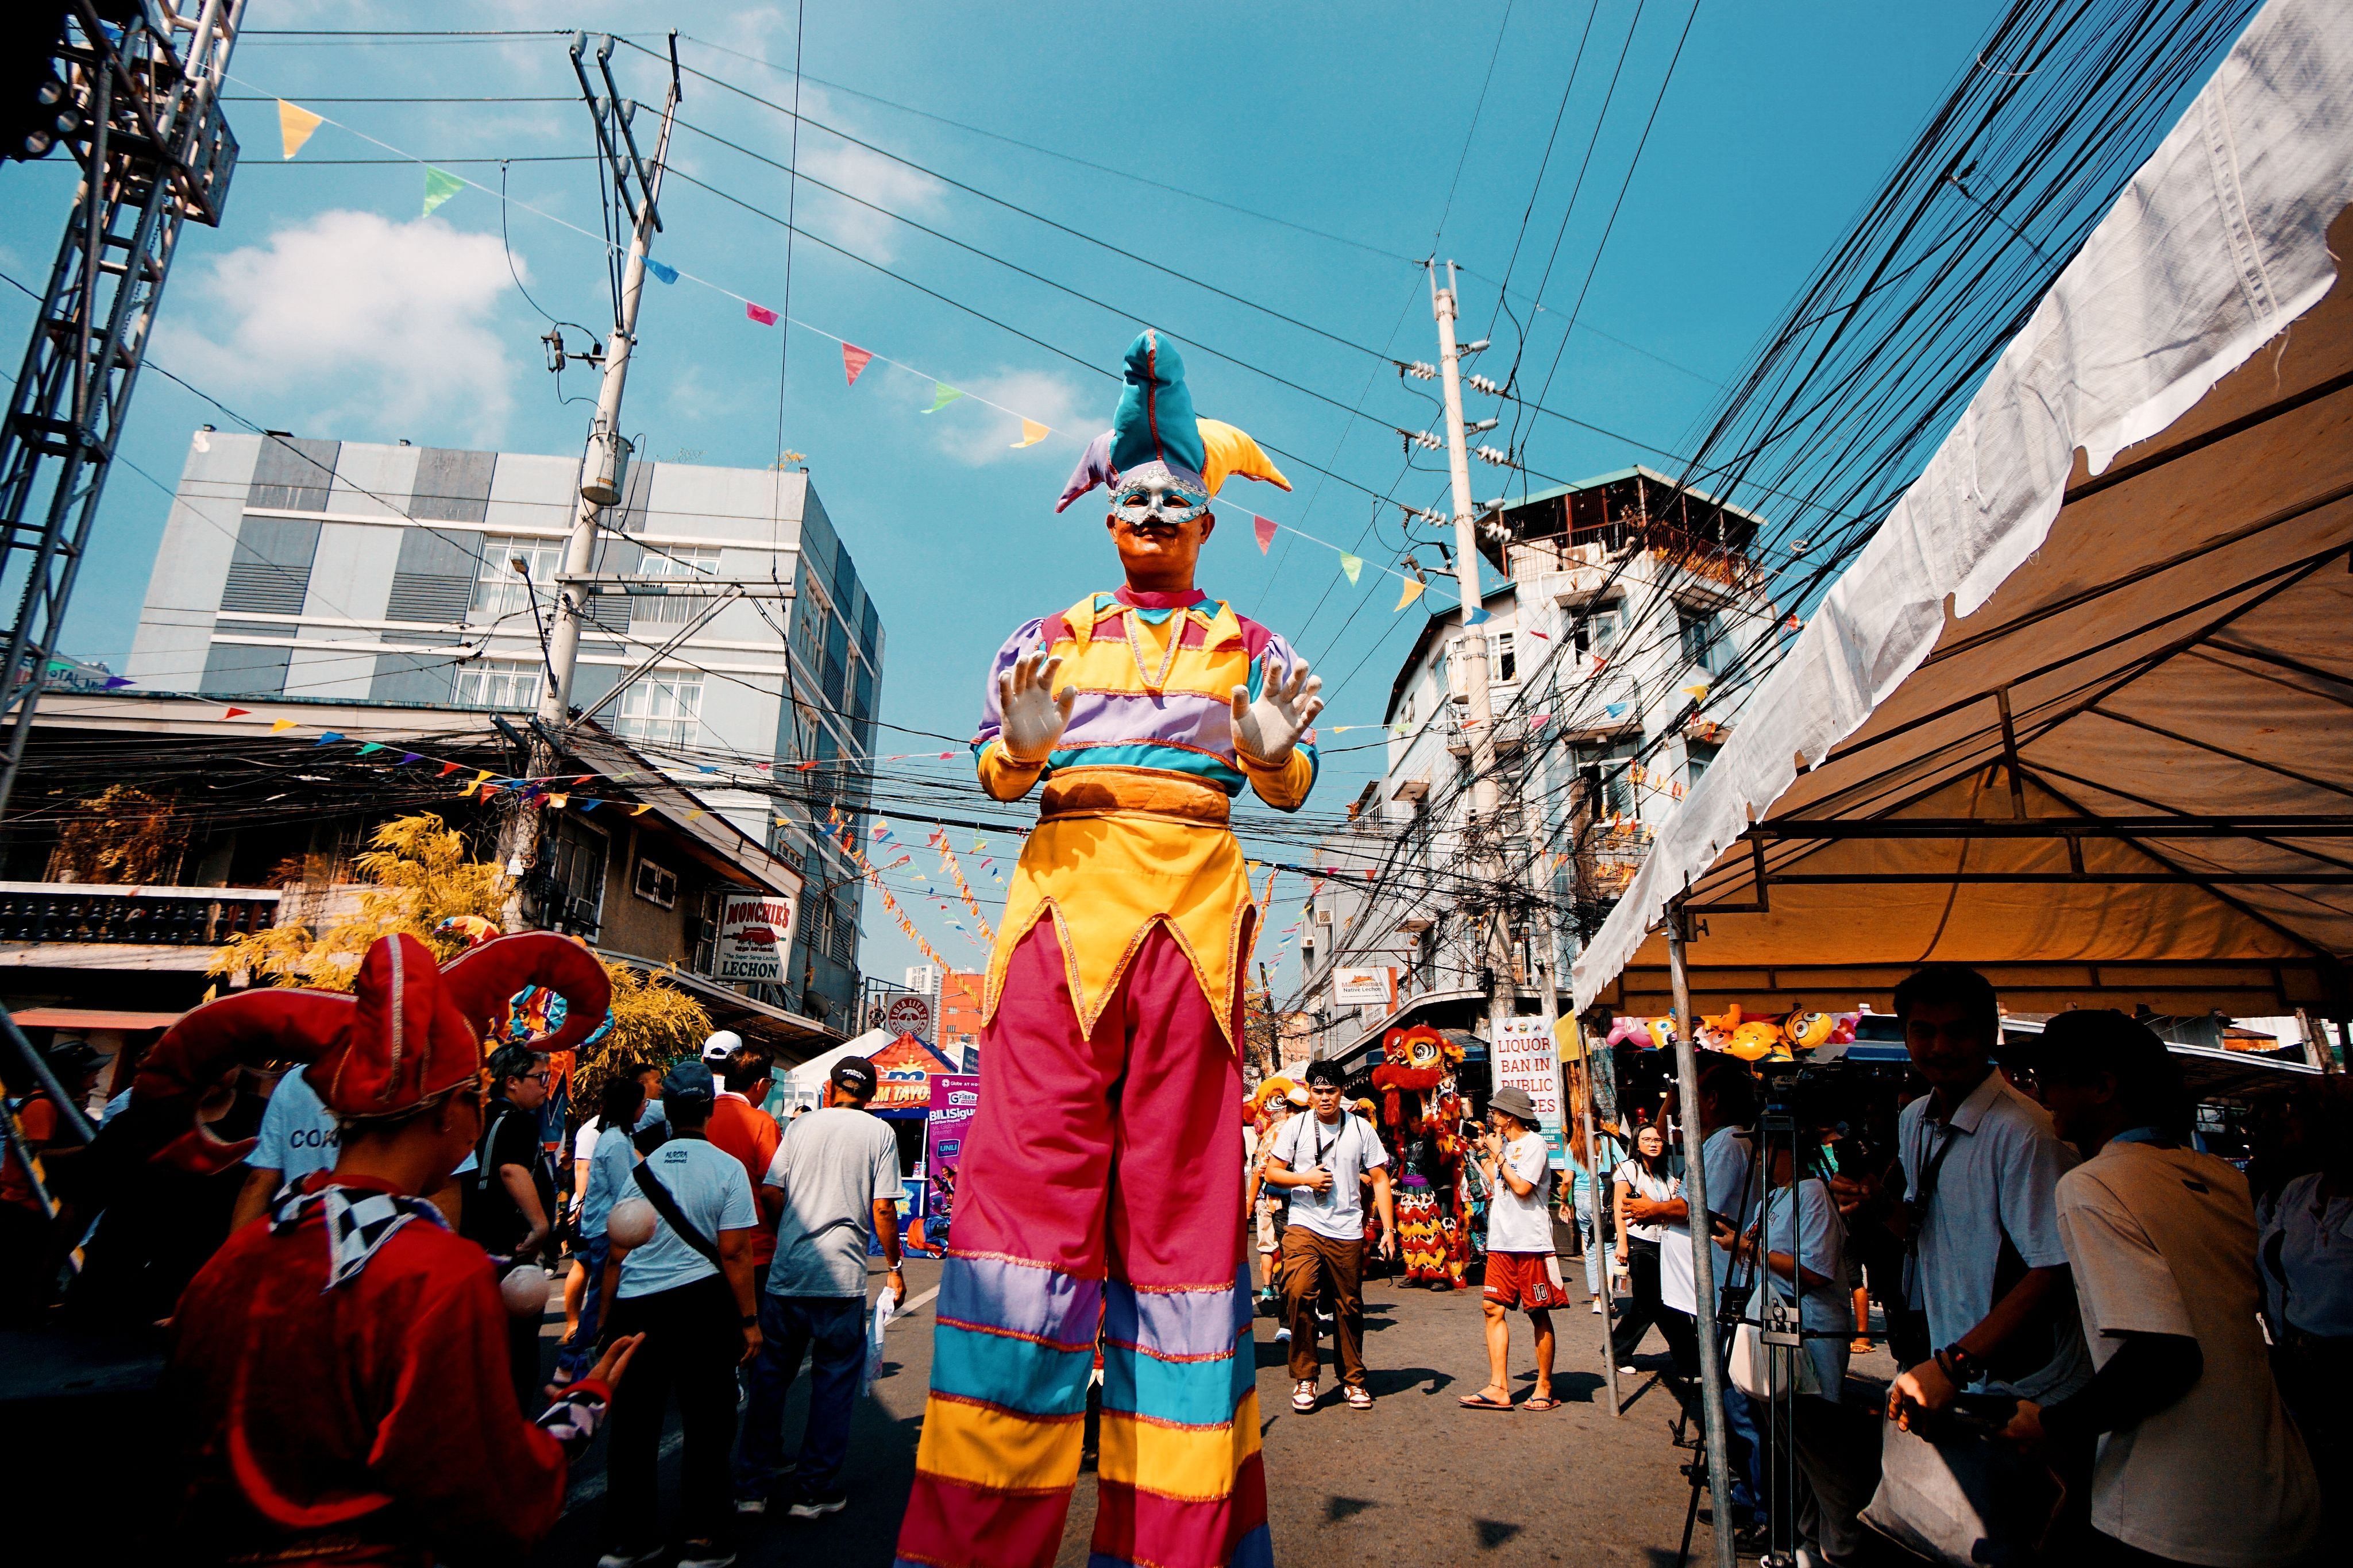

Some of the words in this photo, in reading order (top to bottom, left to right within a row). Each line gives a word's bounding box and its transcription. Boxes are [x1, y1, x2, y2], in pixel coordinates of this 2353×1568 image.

[726, 902, 790, 928] MONCHIE'S
[722, 961, 778, 978] LECHON
[892, 1001, 907, 1017] LOLA
[909, 1000, 927, 1018] LITA'S
[1498, 1037, 1551, 1053] LIQUOR
[1501, 1059, 1530, 1072] BAN
[1534, 1058, 1550, 1071] IN
[1533, 1283, 1548, 1301] 10
